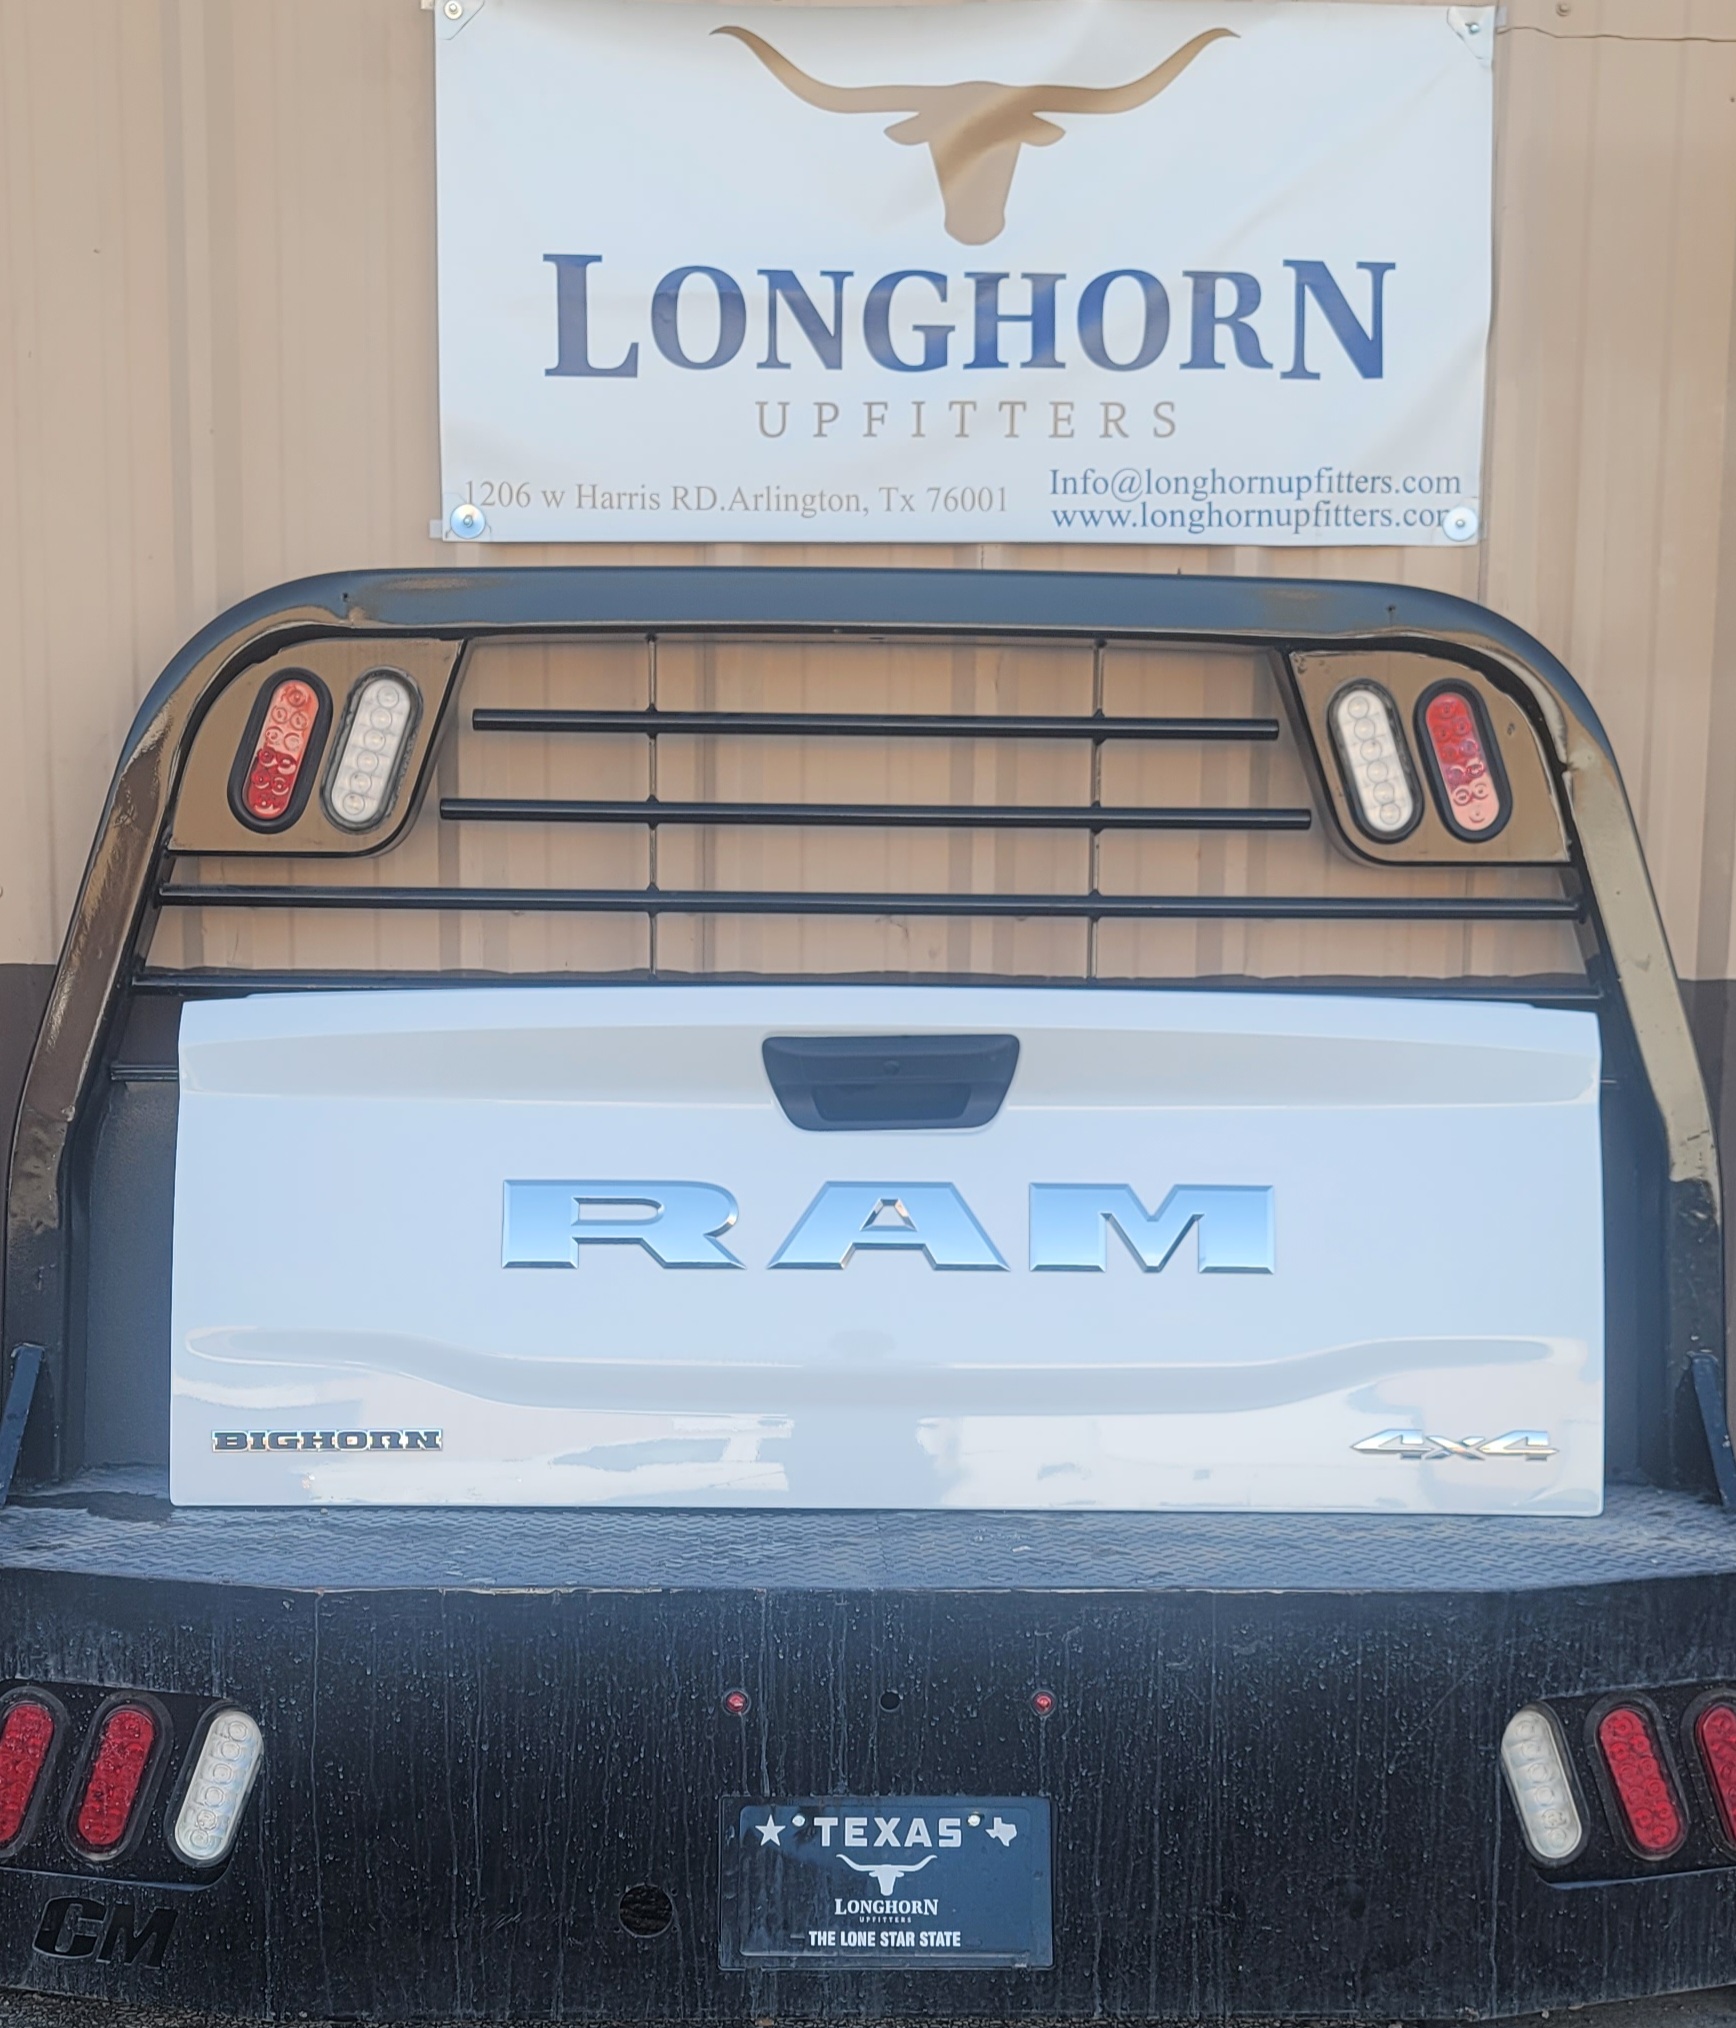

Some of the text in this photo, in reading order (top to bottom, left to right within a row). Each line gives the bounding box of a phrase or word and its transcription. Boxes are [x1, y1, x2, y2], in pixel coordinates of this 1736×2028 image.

[543, 254, 1396, 379] LONGHORN
[756, 401, 1178, 438] UPFITTERS
[465, 480, 531, 508] 1206
[575, 484, 660, 511] Harris
[879, 487, 915, 512] Tx
[926, 487, 1007, 512] 76001
[1049, 468, 1461, 501] Info@longhornupfitters.com
[502, 1179, 1276, 1274] RAM
[211, 1429, 443, 1452] BIGHORN
[1350, 1428, 1560, 1461] 4x4
[813, 1817, 962, 1847] TEXAS
[834, 1898, 939, 1916] LONGHORN
[32, 1896, 178, 1970] CM
[809, 1931, 961, 1947] THE LONE STAR STATE
